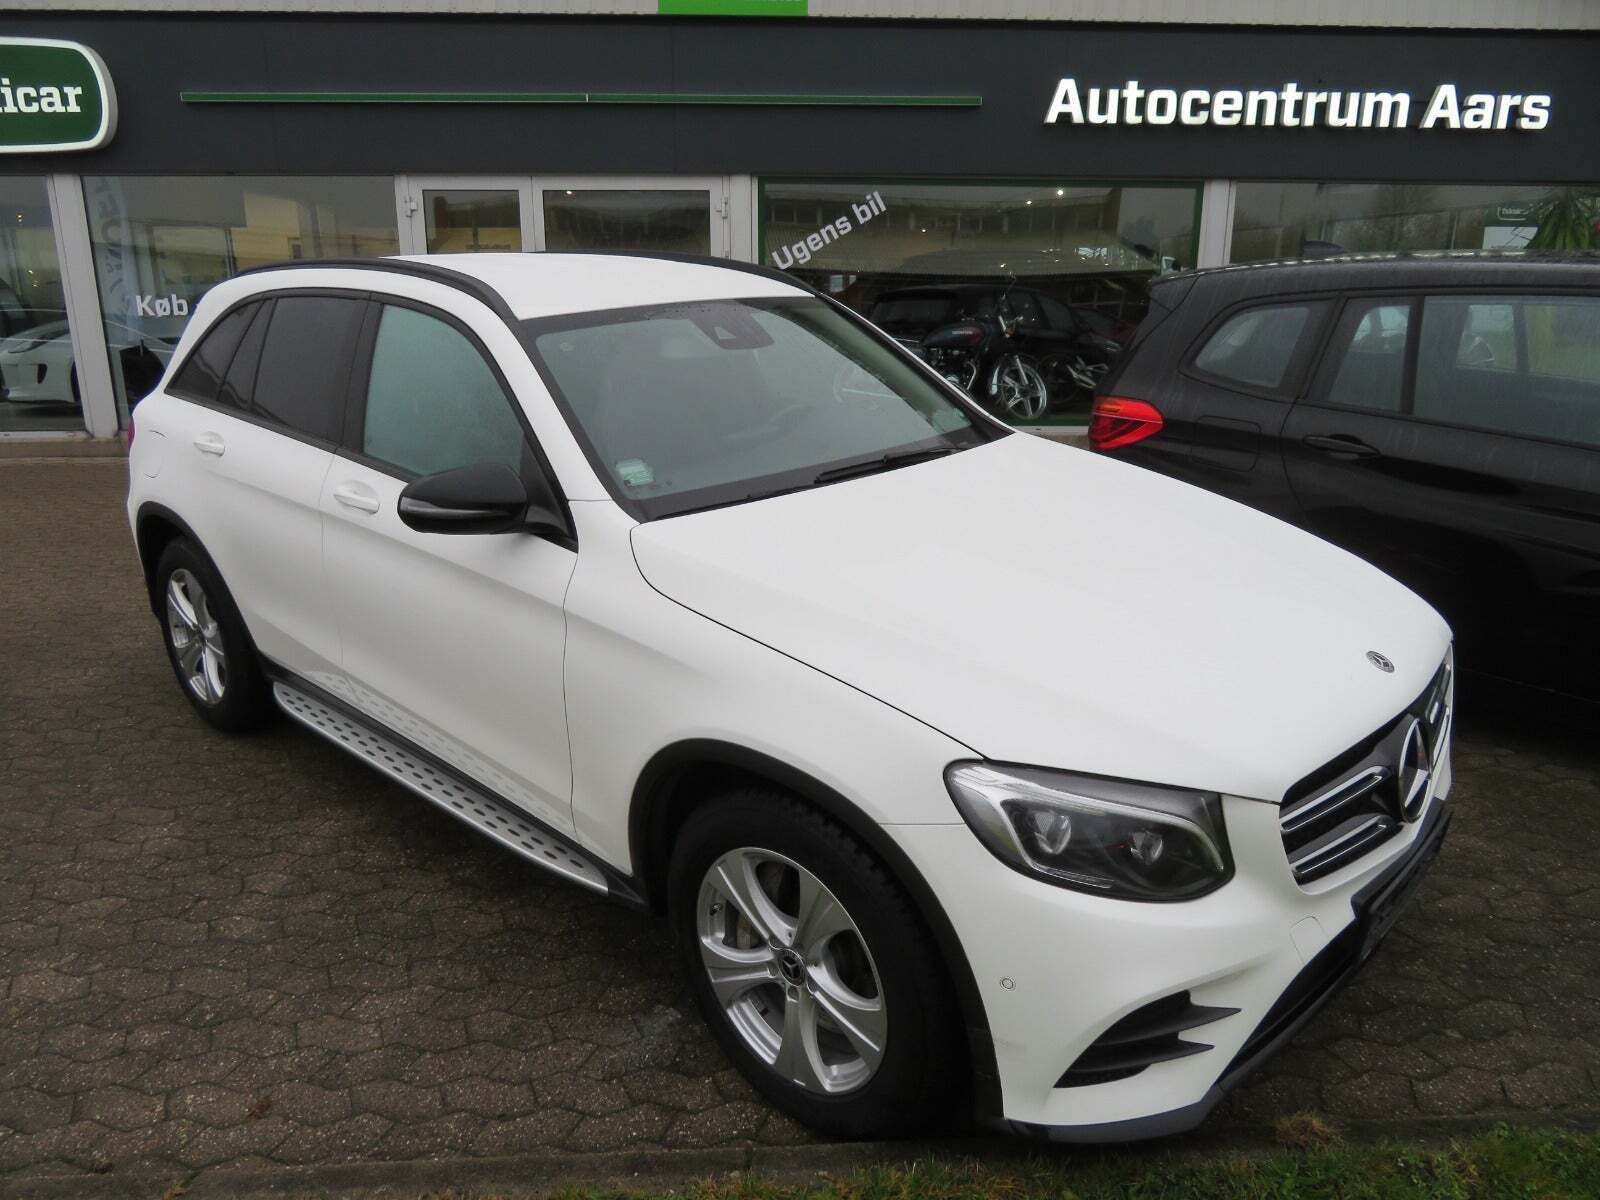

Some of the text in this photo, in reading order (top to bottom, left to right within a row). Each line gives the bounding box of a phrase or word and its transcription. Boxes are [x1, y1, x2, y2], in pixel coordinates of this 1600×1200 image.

[0, 77, 83, 113] icar
[1044, 78, 1551, 130] Autocentrum Aars
[771, 191, 887, 270] Ugens bil
[135, 293, 189, 318] Køb
